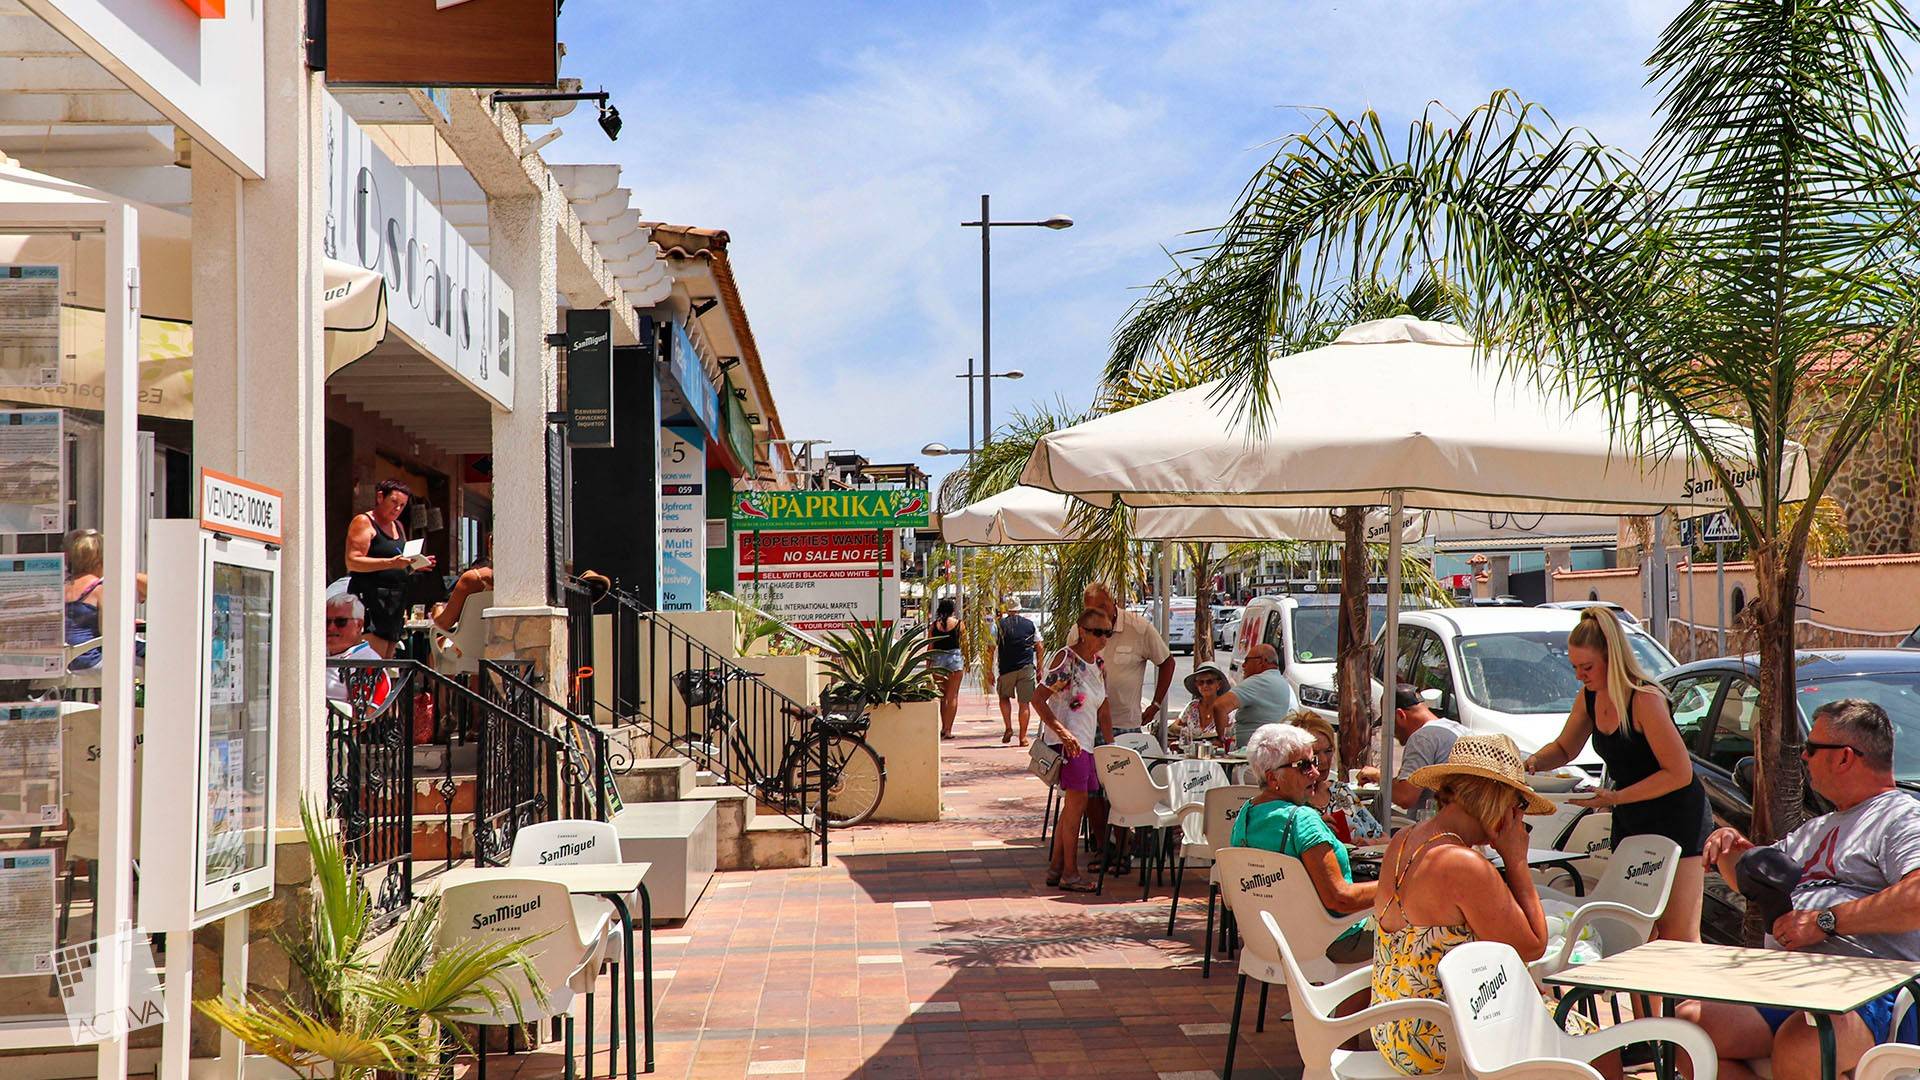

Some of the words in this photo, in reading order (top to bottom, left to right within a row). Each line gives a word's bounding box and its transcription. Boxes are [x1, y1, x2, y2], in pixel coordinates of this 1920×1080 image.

[354, 166, 470, 350] Oscars
[672, 441, 685, 463] 5
[678, 486, 693, 494] 059
[662, 502, 693, 512] Upfront
[771, 495, 891, 519] PAPRIKA
[1681, 521, 1690, 542] P
[665, 539, 693, 549] Multi
[674, 550, 693, 558] Fees
[783, 551, 802, 562] NO
[806, 550, 838, 561] SALE
[841, 549, 860, 560] NO
[663, 592, 676, 600] No
[784, 602, 829, 611] INTERNATIONAL
[1183, 771, 1212, 793] SanMiguel
[539, 836, 595, 865] SanMiguel
[1624, 856, 1665, 880] SanMiguel
[1240, 868, 1285, 892] SanMiguel
[471, 895, 541, 930] SanMiguel
[1470, 964, 1507, 1020] SanMiguel
